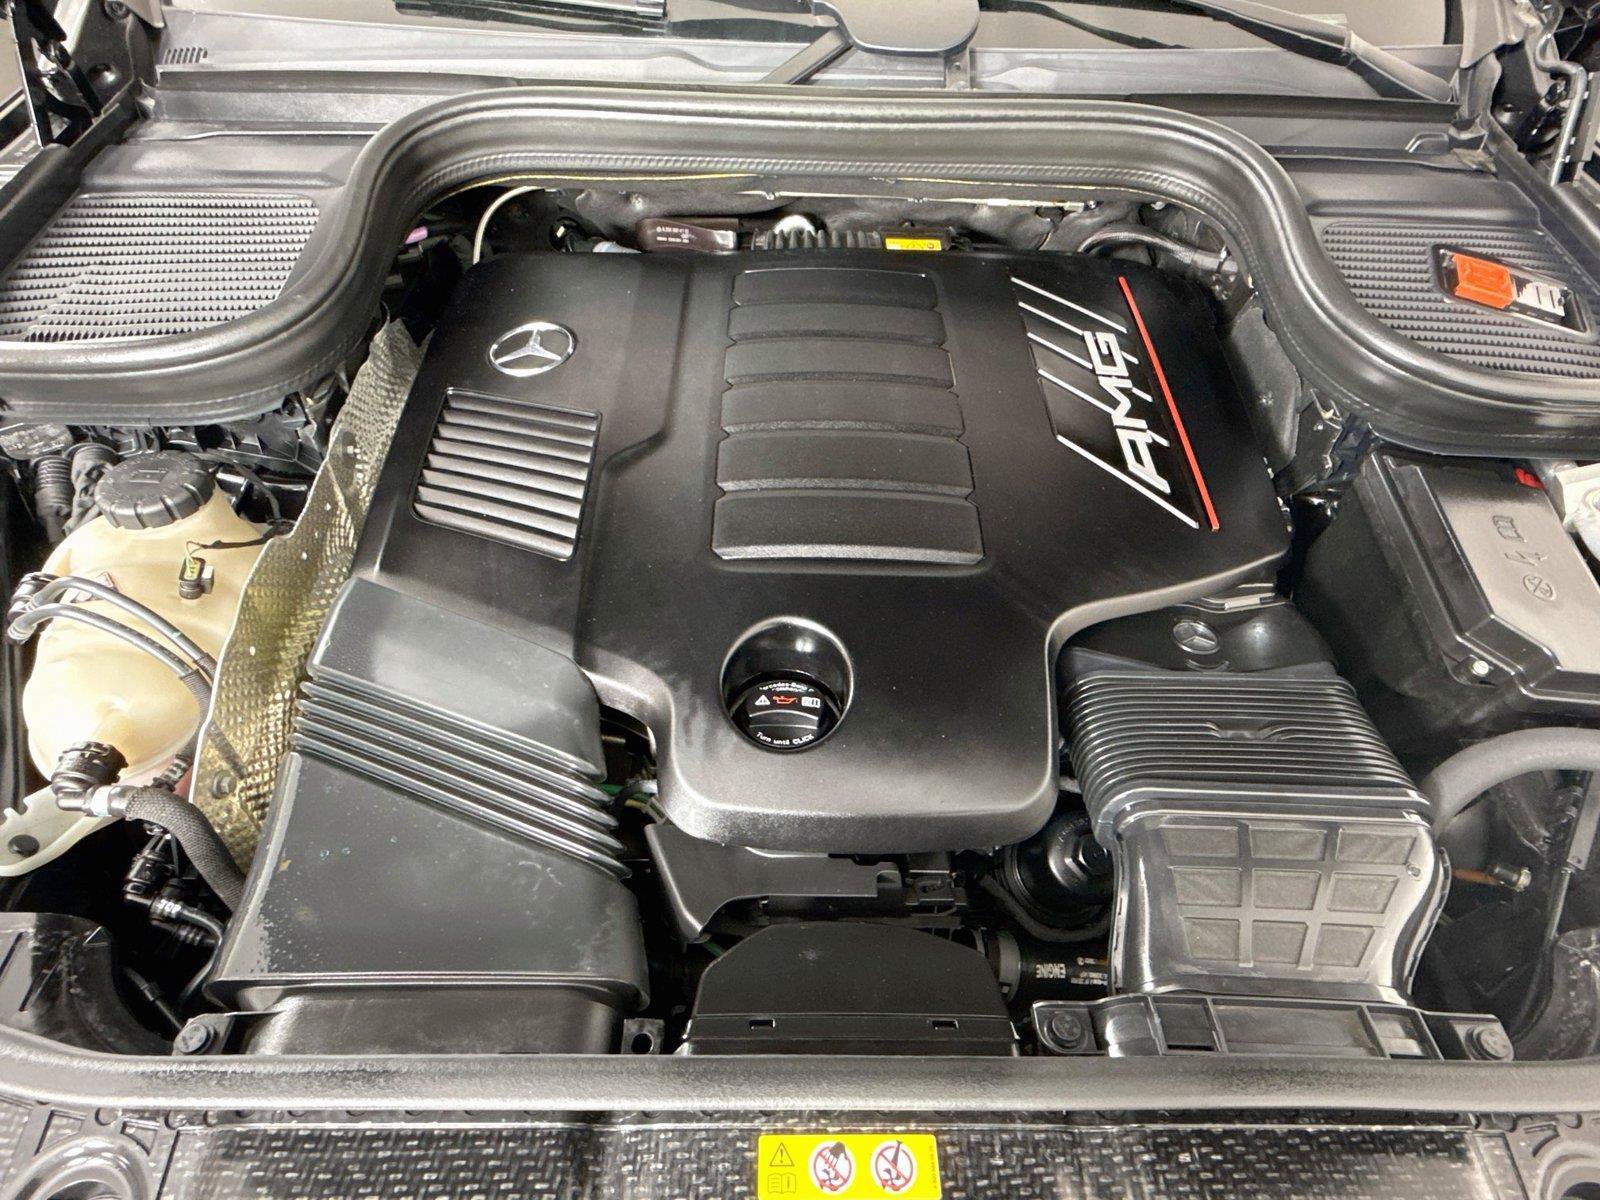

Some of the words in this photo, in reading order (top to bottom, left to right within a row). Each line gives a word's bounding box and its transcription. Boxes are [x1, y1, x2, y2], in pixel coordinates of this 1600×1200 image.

[1083, 330, 1171, 494] AMG
[756, 731, 772, 743] Turn
[792, 733, 815, 745] CLICK
[1035, 963, 1066, 979] ENGINE
